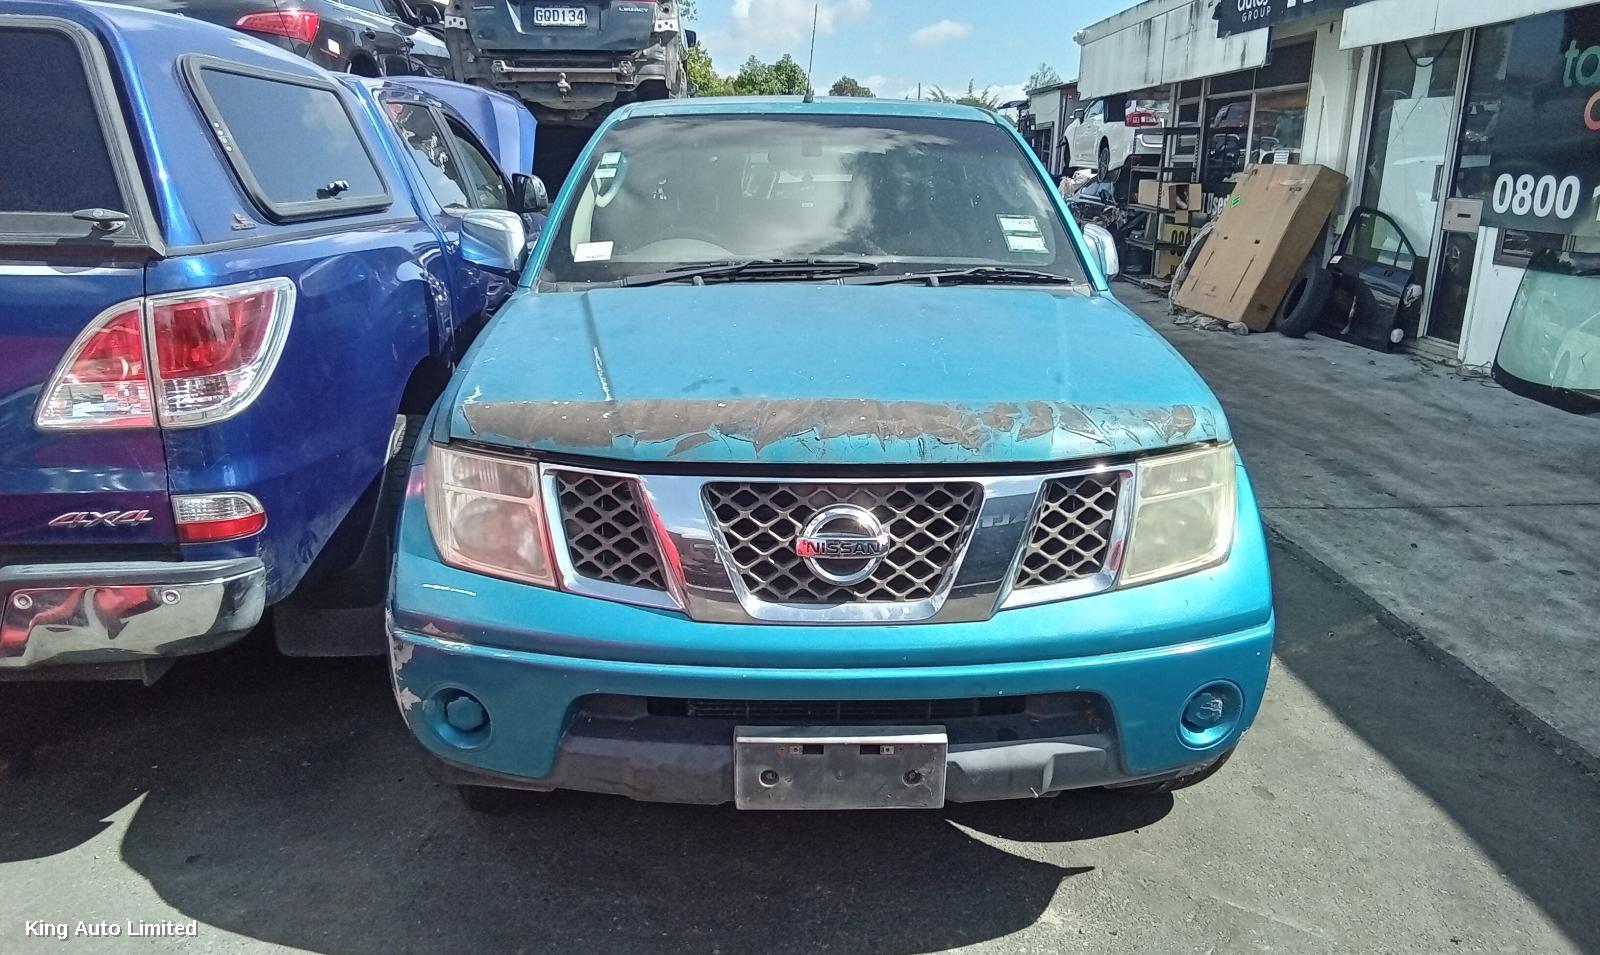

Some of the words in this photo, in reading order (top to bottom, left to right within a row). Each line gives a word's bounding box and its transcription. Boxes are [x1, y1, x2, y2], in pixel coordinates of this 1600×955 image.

[535, 9, 584, 22] GQD134
[1241, 5, 1271, 23] GROUP
[1492, 173, 1581, 219] 0800
[805, 541, 880, 555] NISSAN
